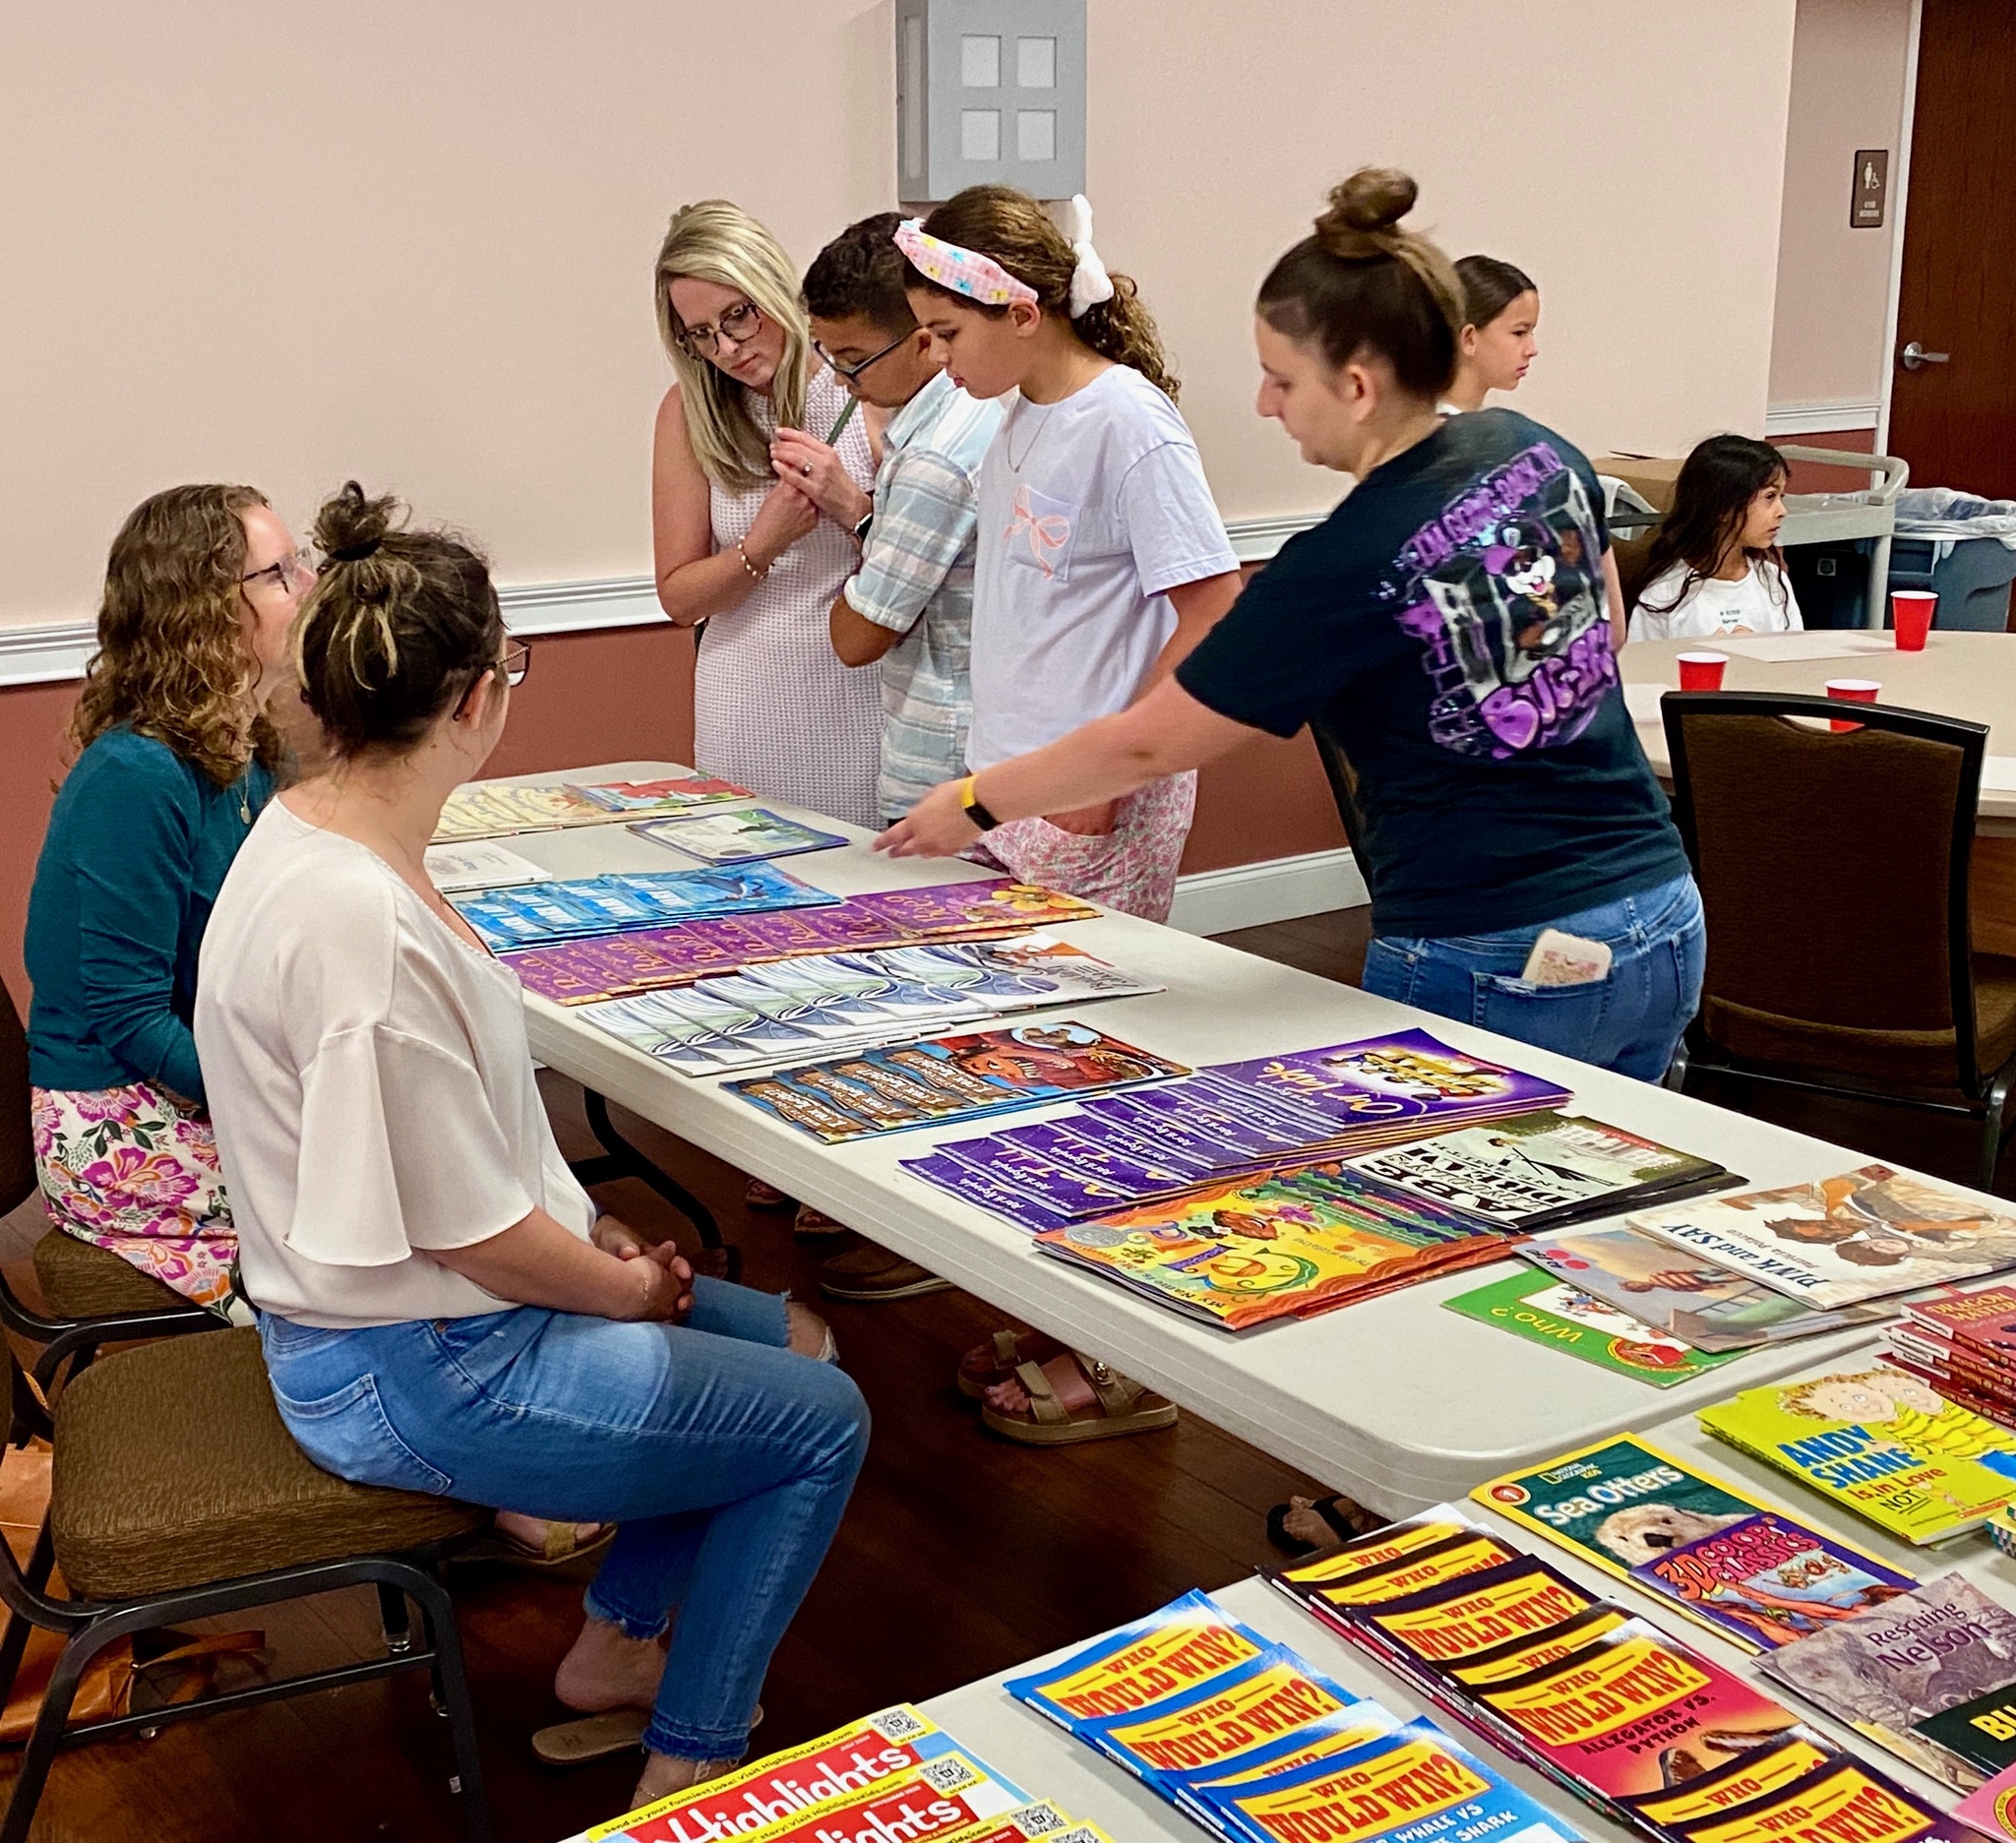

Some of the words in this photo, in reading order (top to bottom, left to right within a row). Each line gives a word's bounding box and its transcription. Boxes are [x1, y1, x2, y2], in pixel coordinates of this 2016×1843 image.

[1256, 1061, 1345, 1095] Table
[1322, 1091, 1404, 1114] Our
[1401, 1145, 1572, 1203] DREAM
[1429, 1141, 1512, 1174] SMITH
[1360, 1157, 1533, 1213] ABE
[1384, 1152, 1542, 1210] LINCOLN'S
[1523, 1174, 1590, 1198] LANE
[1662, 1224, 1719, 1247] SAY
[1726, 1229, 1772, 1253] Polacco
[1719, 1240, 1754, 1266] and
[1772, 1248, 1820, 1268] Patricia
[1153, 1278, 1195, 1301] Name
[1751, 1258, 1830, 1288] PINK
[1198, 1295, 1226, 1309] My
[1924, 1292, 2015, 1315] DRAGON
[1777, 1424, 1877, 1469] ANDY
[1810, 1447, 1926, 1490] SHANE
[1847, 1486, 1868, 1501] Is
[1874, 1478, 1893, 1496] in
[1898, 1467, 1947, 1490] Love
[1501, 1489, 1520, 1503] 1
[1534, 1494, 1597, 1526] Sea
[1589, 1465, 1684, 1505] Otters
[1879, 1489, 1923, 1513] NOT
[1349, 1546, 1402, 1567] WHO
[1695, 1525, 1771, 1565] COLOR
[1709, 1532, 1821, 1583] CLASSICS
[1386, 1565, 1440, 1589] WHO
[1392, 1615, 1514, 1662] WOULD
[1496, 1584, 1586, 1635] WIN?
[1439, 1596, 1496, 1620] WHO
[1867, 1602, 1968, 1647] Rescuing
[1102, 1645, 1158, 1675] WHO
[1516, 1644, 1572, 1670] WHO
[1876, 1622, 1993, 1673] Nelson
[1055, 1666, 1179, 1719] WOULD
[1159, 1625, 1252, 1679] WIN?
[1546, 1669, 1602, 1696] WHO
[1178, 1699, 1237, 1727] WHO
[1504, 1690, 1626, 1743] WOULD
[1603, 1650, 1699, 1705] WIN?
[1128, 1720, 1256, 1772] WOULD
[1236, 1678, 1336, 1735] WIN?
[1578, 1707, 1682, 1755] ALLIGATOR
[1682, 1693, 1717, 1712] VS.
[1624, 1716, 1701, 1755] PYTHON
[603, 1818, 630, 1833] Send
[632, 1813, 643, 1823] us
[644, 1804, 667, 1819] your
[668, 1787, 713, 1809] funniest
[738, 1765, 761, 1780] Visit
[762, 1730, 854, 1771] HighlightsKids.com
[652, 1745, 912, 1843] Highlights
[1252, 1786, 1391, 1843] WOULD
[1373, 1753, 1478, 1813] WIN?
[1310, 1771, 1374, 1799] WHO
[1704, 1777, 1763, 1808] WHO
[761, 1825, 789, 1840] story!
[790, 1813, 812, 1827] Visit
[812, 1779, 902, 1822] HighlightsKids.com
[1394, 1814, 1458, 1842] WHALE
[1455, 1803, 1486, 1821] VS
[1754, 1806, 1813, 1833] WHO
[1815, 1786, 1919, 1843] WIN?
[1454, 1810, 1520, 1843] SHARK
